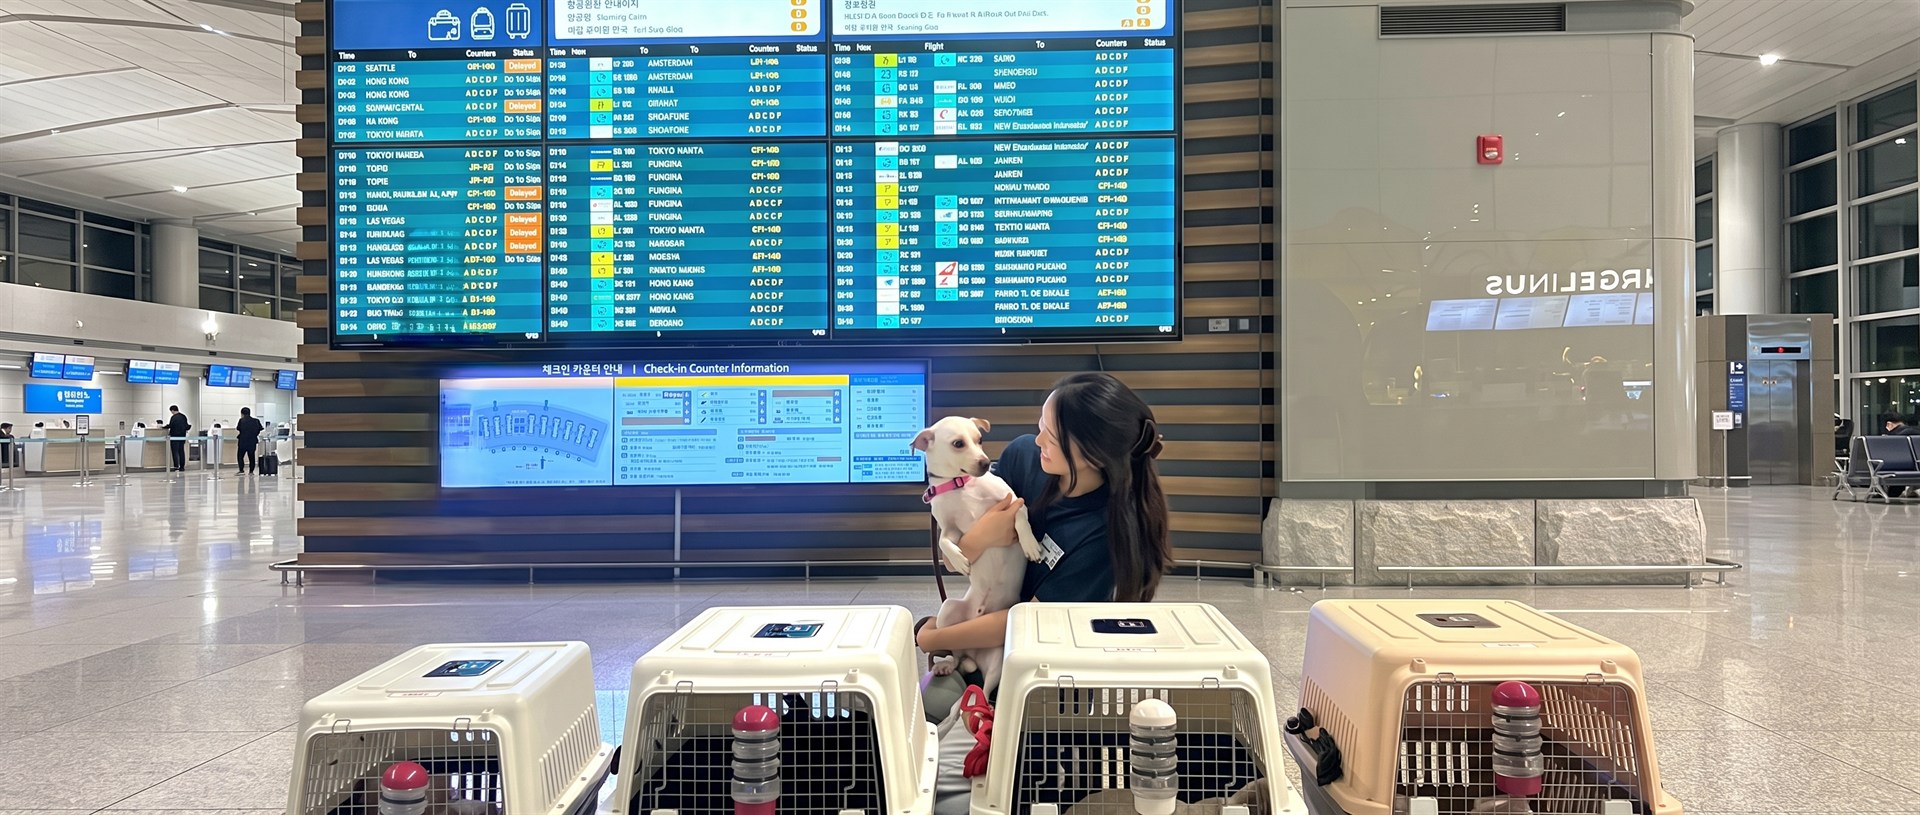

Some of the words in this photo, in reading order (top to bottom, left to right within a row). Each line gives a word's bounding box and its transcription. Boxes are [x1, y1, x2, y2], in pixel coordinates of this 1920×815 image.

[749, 45, 779, 53] Counters
[796, 44, 818, 53] Status
[924, 42, 945, 51] Flight
[1036, 41, 1045, 49] To
[1096, 39, 1128, 48] Counters
[1144, 38, 1166, 46] Status
[466, 49, 496, 57] Counters
[513, 49, 534, 57] Status
[365, 64, 396, 72] SEATTLE
[647, 59, 693, 68] AMSTERDAM
[365, 77, 387, 85] HONG
[388, 77, 409, 85] KONG
[647, 72, 693, 81] AMSTERDAM
[365, 91, 387, 99] HONG
[388, 90, 410, 98] KONG
[378, 117, 399, 125] KONG
[648, 147, 675, 155] TOKYO
[677, 146, 704, 154] NANTA
[366, 217, 380, 225] LAS
[381, 217, 405, 225] VEGAS
[366, 257, 380, 265] LAS
[542, 364, 570, 375] 체크인
[573, 364, 601, 375] 카운터
[603, 364, 623, 375] 안내
[644, 364, 687, 374] Check-in
[689, 364, 729, 373] Counter
[731, 363, 790, 373] Information
